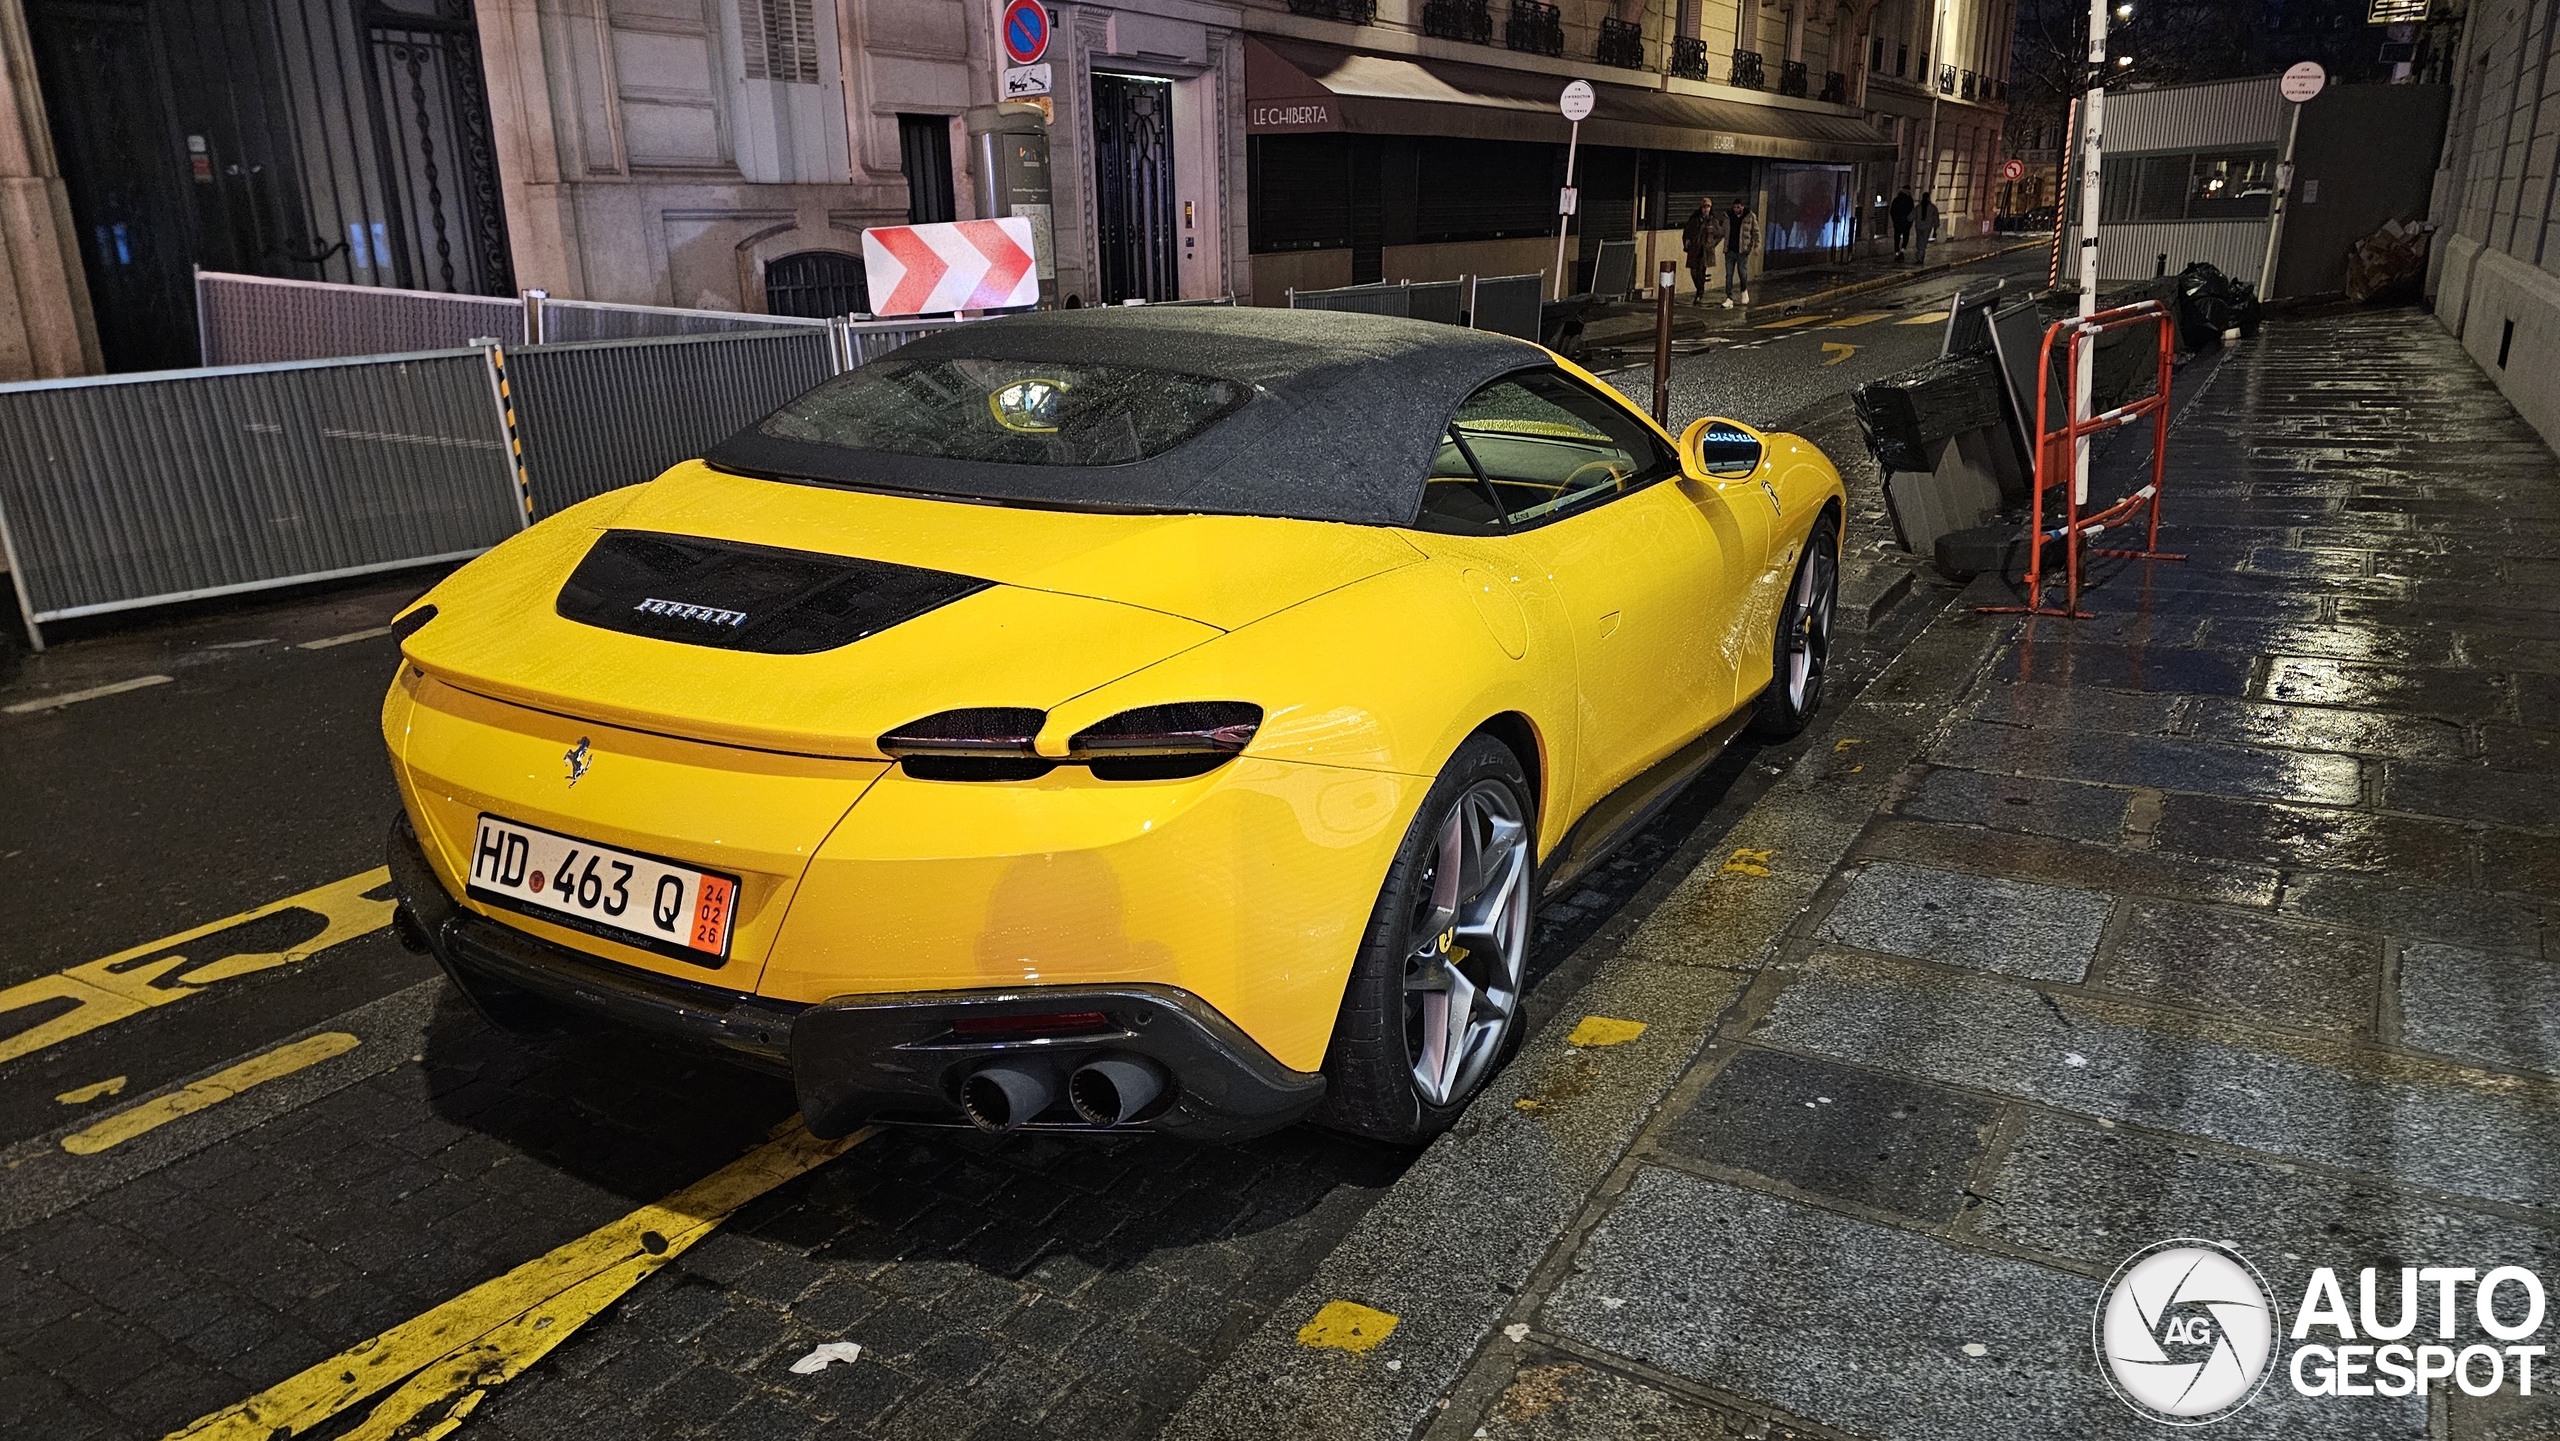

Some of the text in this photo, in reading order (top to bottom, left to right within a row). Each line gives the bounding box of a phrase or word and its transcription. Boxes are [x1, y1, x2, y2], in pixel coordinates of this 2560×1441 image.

[1253, 106, 1328, 125] LE CHIBERTA
[633, 598, 747, 628] Ferrari
[475, 826, 685, 933] HD 463 Q
[704, 884, 724, 905] 24
[701, 904, 721, 925] 02
[697, 924, 718, 944] 26
